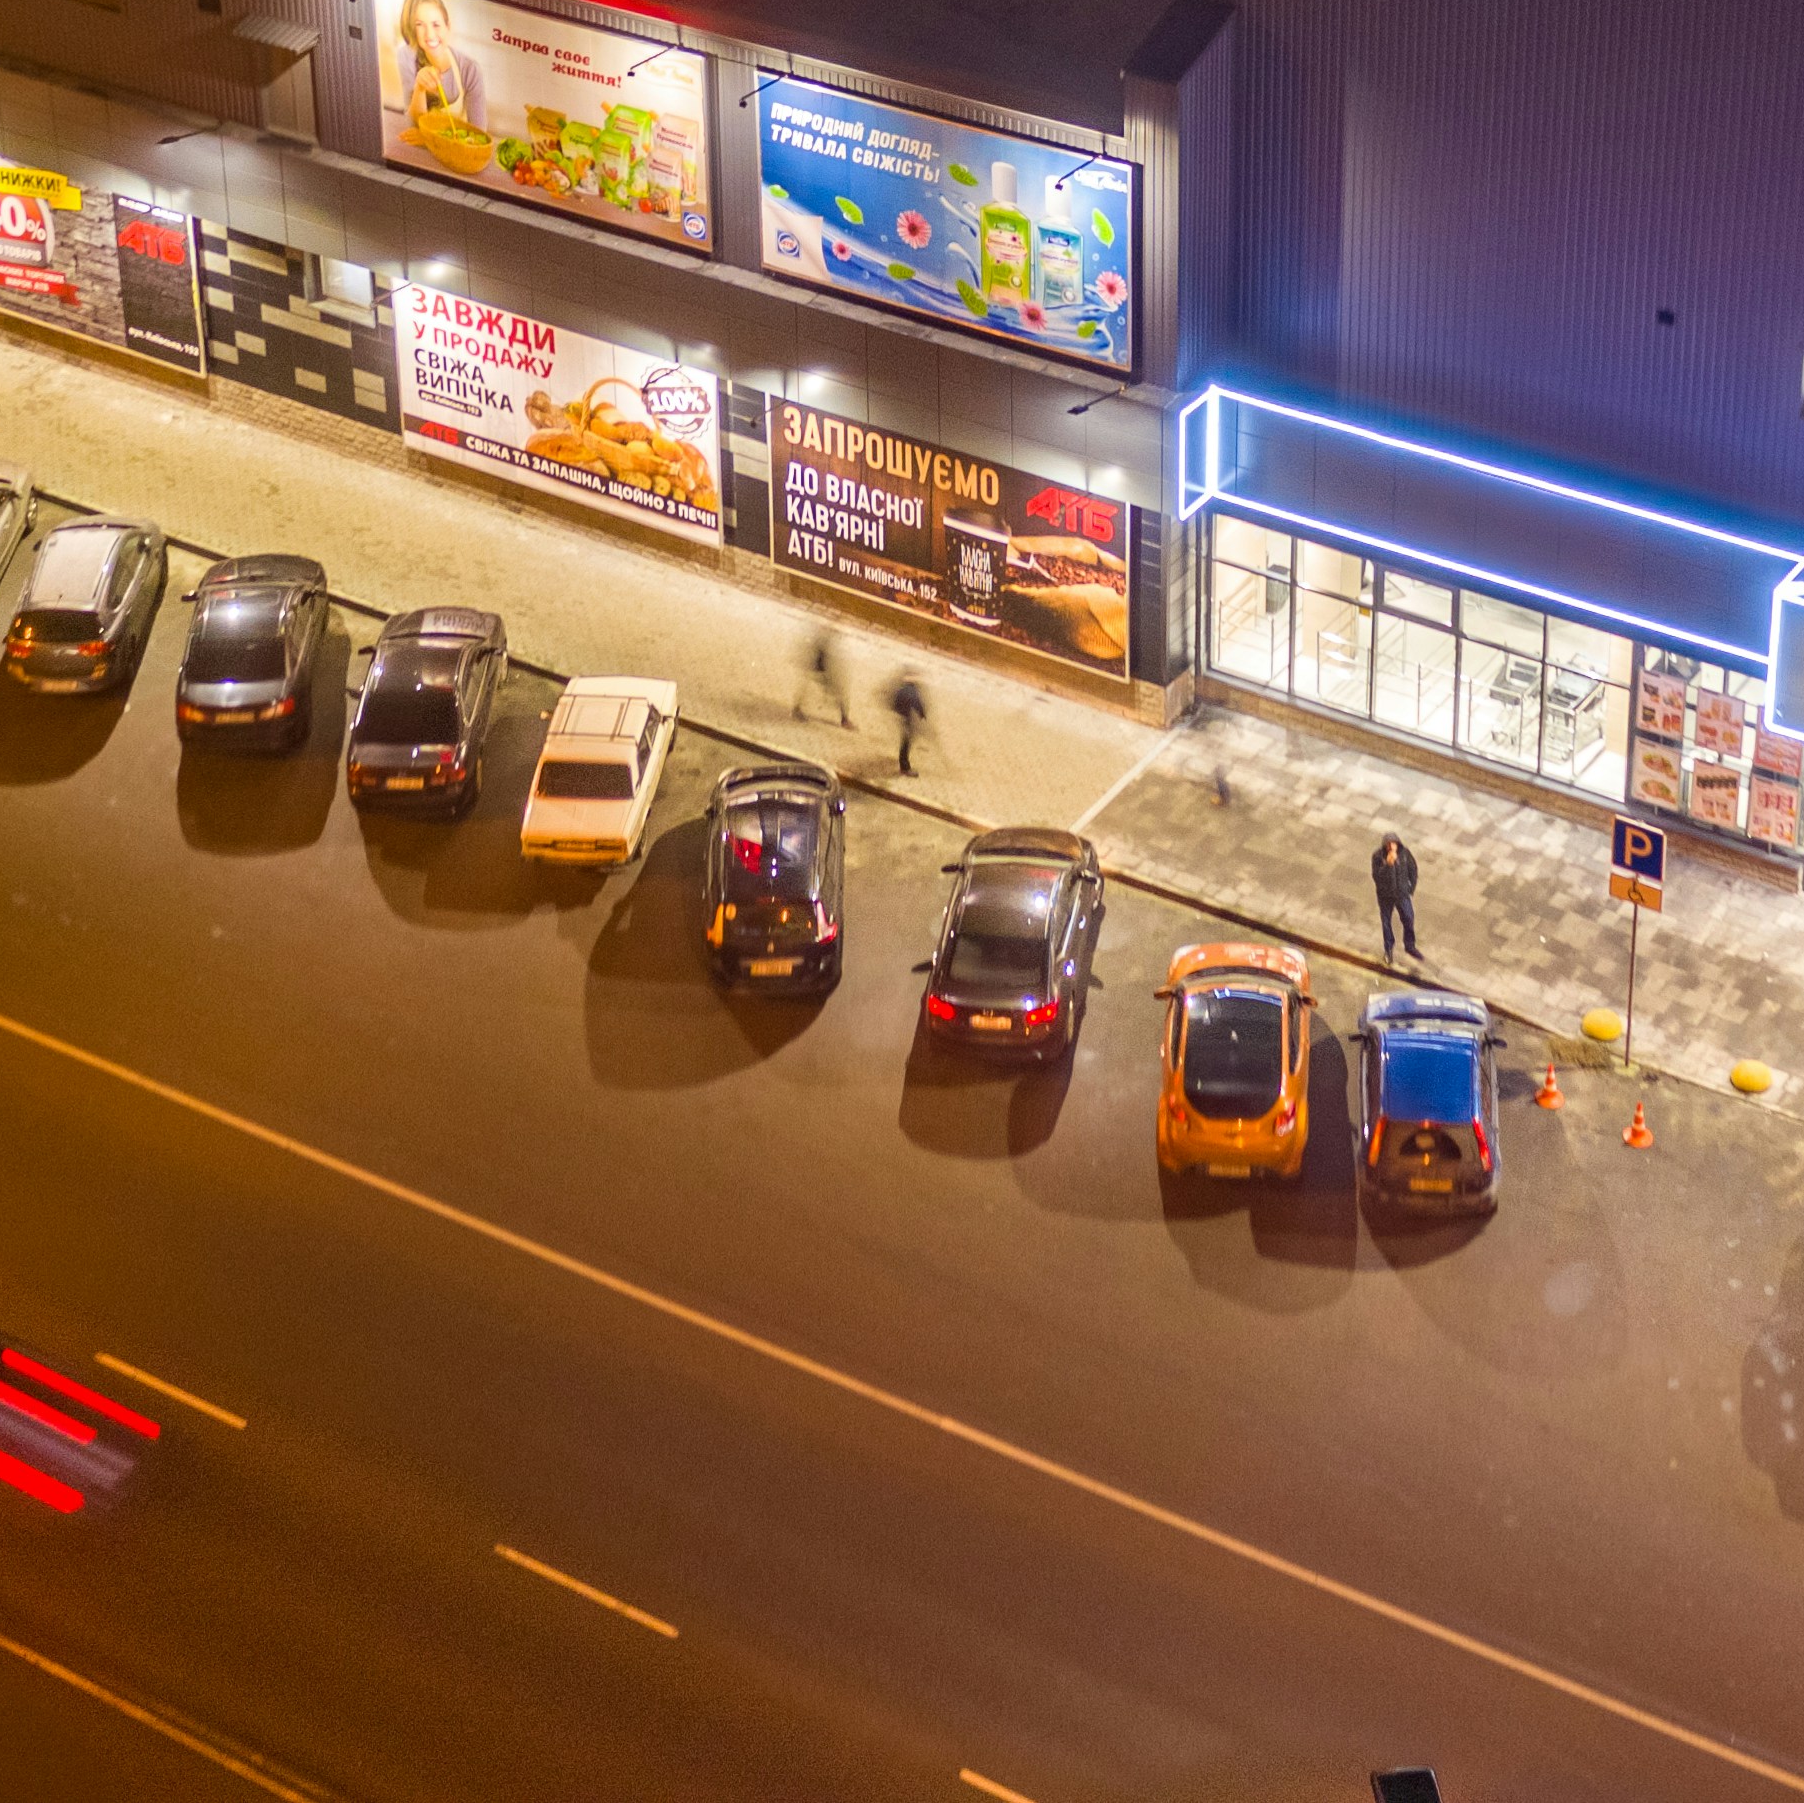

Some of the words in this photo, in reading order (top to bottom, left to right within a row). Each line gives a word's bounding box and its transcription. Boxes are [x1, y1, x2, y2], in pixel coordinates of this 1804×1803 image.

[552, 62, 623, 89] життя!
[770, 102, 865, 143] ПРИРОДНИЙ
[770, 124, 847, 161] ТРИВАЛА
[851, 147, 941, 184] СВІЖІСТЬ!
[117, 219, 188, 266] АТБ
[411, 287, 556, 355] ЗАВЖДИ
[413, 321, 426, 339] У
[433, 327, 554, 379] ПРОДАЖУ
[413, 347, 485, 385] СВІЖА
[415, 367, 514, 413] ВИПІЧКА
[648, 385, 706, 413] 100%
[419, 421, 459, 446] АТБ
[465, 435, 510, 462] СВІЖА
[511, 451, 530, 468] ТА
[532, 456, 606, 494] ЗАПАШНА,
[608, 480, 665, 511] ЩОЙНО
[666, 499, 676, 515] З
[783, 405, 1000, 506] ЗАПРОШУЄМО
[785, 461, 819, 496] ДО
[826, 474, 924, 529] ВЛАСНОЇ
[1026, 486, 1120, 543] АТБ
[787, 528, 834, 568] АТБ!
[837, 557, 862, 579] ВУЛ.
[863, 562, 916, 597] КИЇВСЬКА,
[919, 582, 938, 601] 152
[1623, 827, 1652, 867] P
